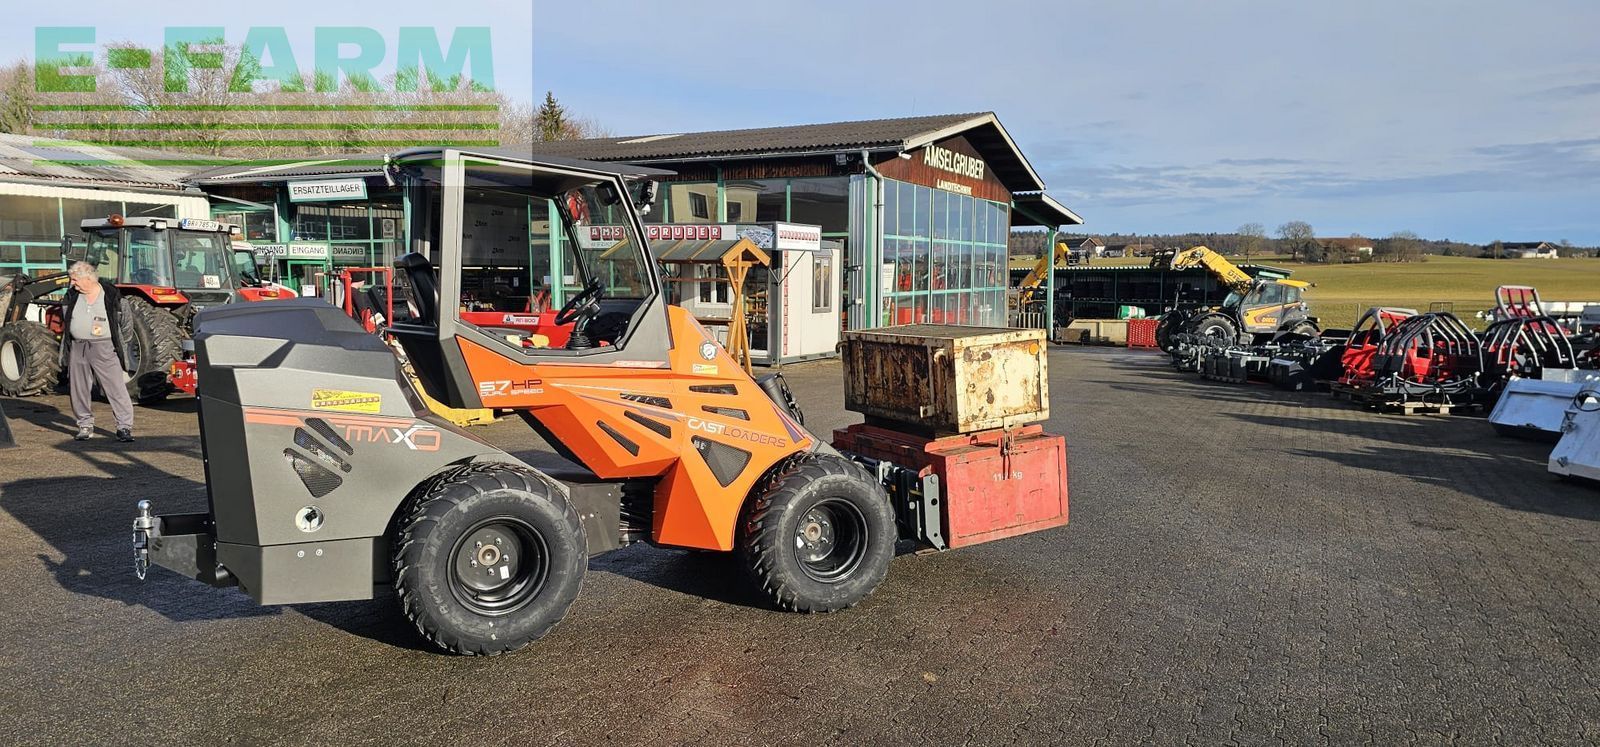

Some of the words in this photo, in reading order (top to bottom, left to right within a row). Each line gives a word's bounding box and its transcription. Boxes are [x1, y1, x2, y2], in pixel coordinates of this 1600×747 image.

[923, 145, 985, 180] AMSELGRUBER
[293, 183, 361, 195] ERSATZTEILLAGER
[936, 178, 973, 195] LANDTECHNIK
[292, 246, 325, 255] EINGANG
